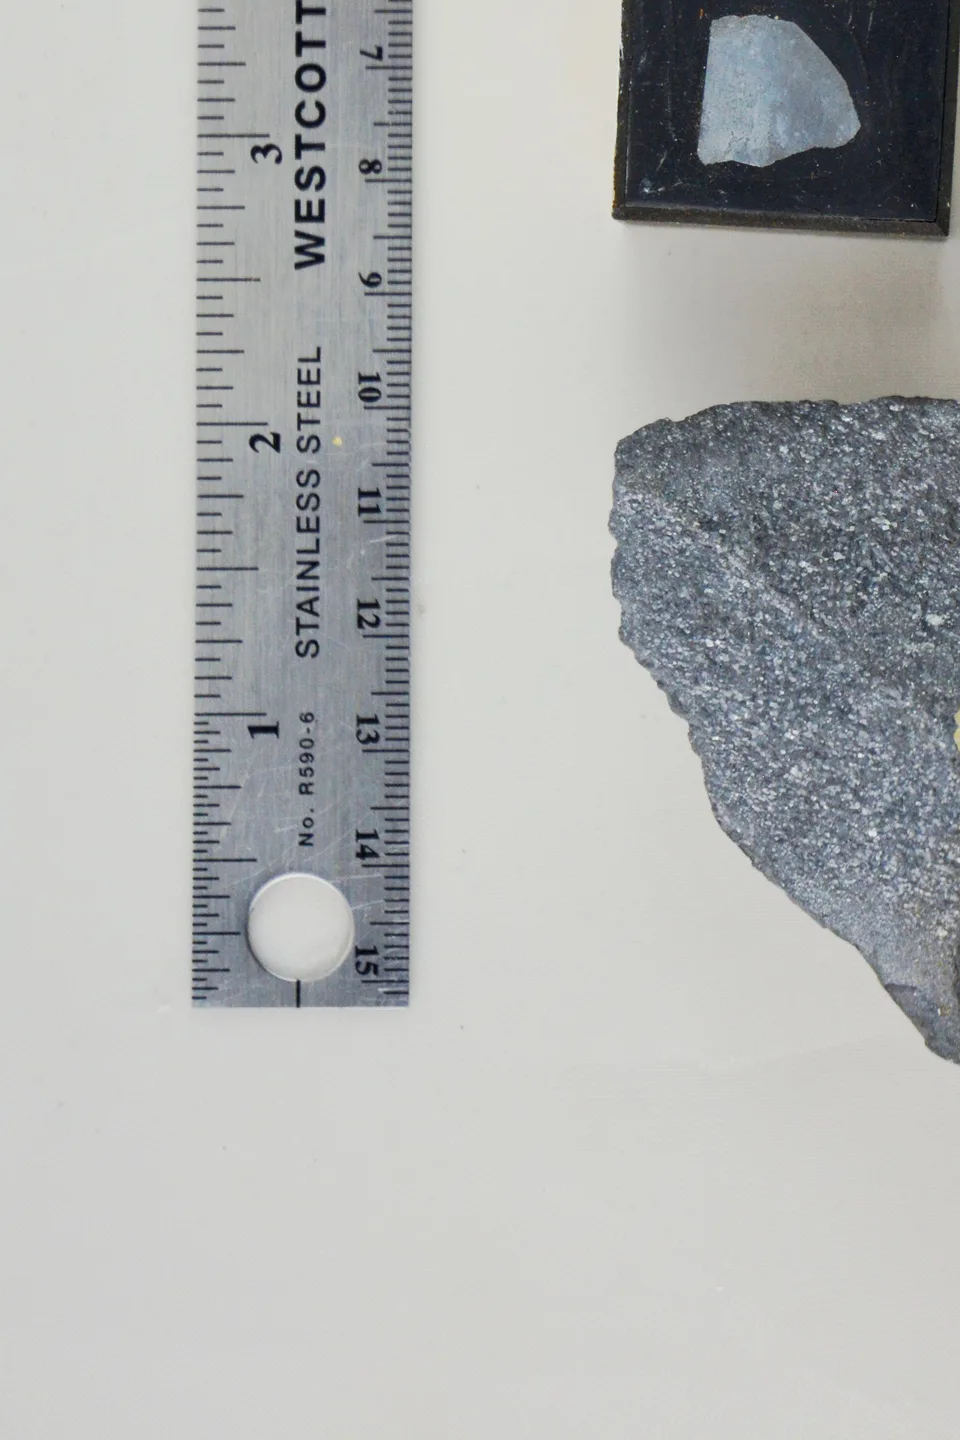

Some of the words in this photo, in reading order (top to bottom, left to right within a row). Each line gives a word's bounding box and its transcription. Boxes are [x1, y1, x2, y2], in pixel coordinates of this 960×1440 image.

[359, 45, 384, 61] 7
[250, 143, 283, 165] 3
[358, 158, 383, 175] 8
[358, 271, 383, 288] 9
[296, 346, 322, 454] STEEL
[357, 371, 382, 403] 10
[249, 431, 281, 453] 2
[357, 487, 382, 517] 11
[295, 468, 321, 659] STAINLESS
[357, 598, 381, 630] 12
[247, 721, 280, 739] 1
[356, 714, 380, 745] 13
[299, 711, 315, 796] R590-6
[298, 808, 315, 847] No.
[355, 828, 380, 861] 14
[355, 945, 379, 976] 15
